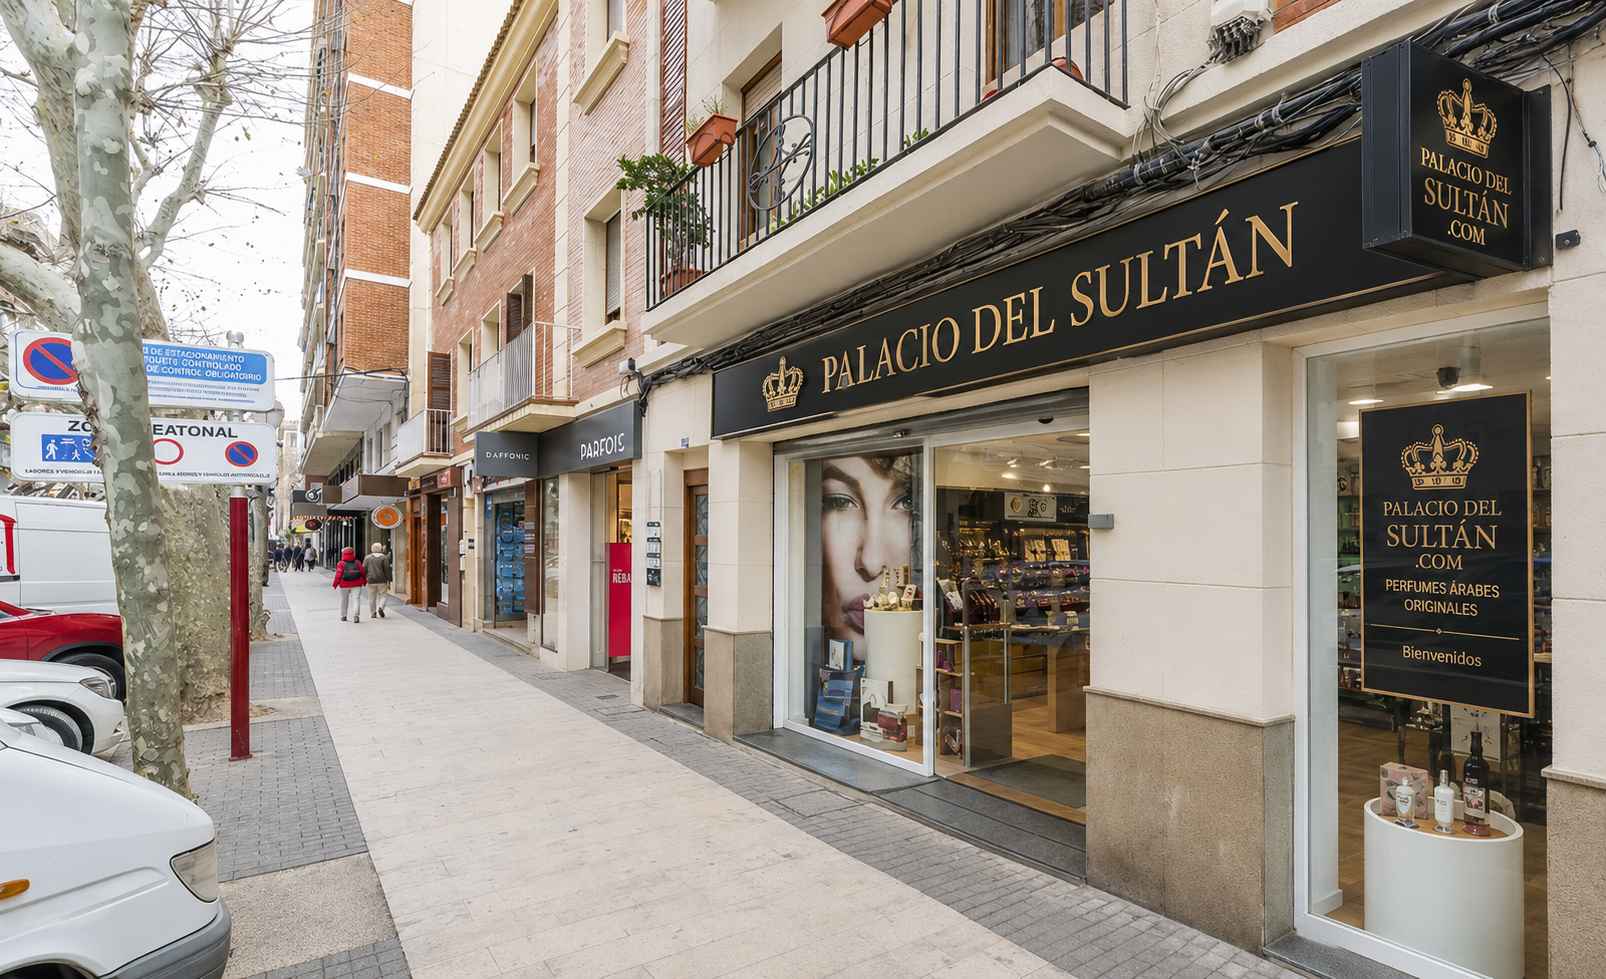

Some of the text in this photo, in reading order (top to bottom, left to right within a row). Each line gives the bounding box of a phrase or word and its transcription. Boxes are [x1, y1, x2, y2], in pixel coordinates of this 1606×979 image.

[1420, 147, 1513, 196] PALACIO DEL
[1424, 177, 1509, 229] SULTÁN
[1447, 219, 1486, 246] .COM
[821, 201, 1299, 394] PALACIO DEL SULTÁN
[152, 424, 239, 438] EATONAL
[580, 432, 625, 461] PARFOIS
[1383, 499, 1502, 517] PALACIO DEL
[1386, 519, 1499, 549] SULTÁN
[1415, 553, 1463, 570] .COM
[612, 572, 632, 583] REBA
[1385, 578, 1500, 598] PERFUMES ÁRABES
[1404, 598, 1478, 617] ORIGINALES
[1402, 644, 1482, 667] Bienvenidos
